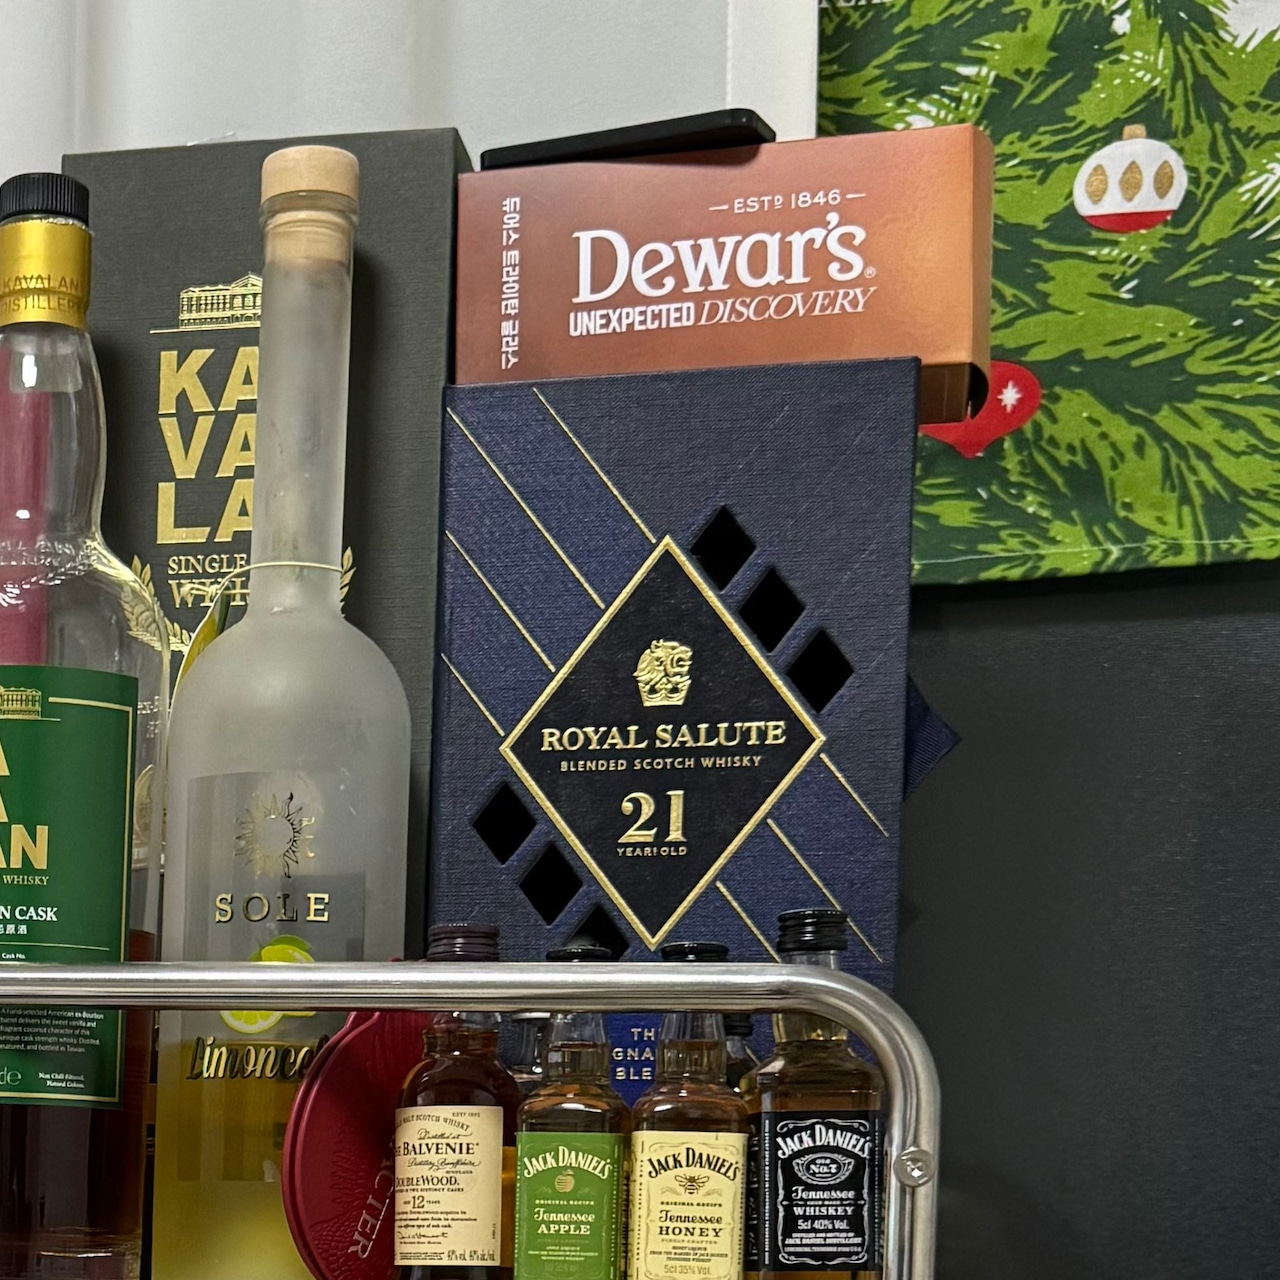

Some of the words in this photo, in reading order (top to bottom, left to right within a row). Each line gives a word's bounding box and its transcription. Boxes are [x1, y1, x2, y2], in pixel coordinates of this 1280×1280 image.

[791, 189, 841, 210] 1846
[502, 197, 520, 246] 듀어스
[571, 212, 867, 304] Dewar's
[1, 274, 80, 293] KAVALAN
[501, 250, 520, 315] 트라이탄
[569, 302, 695, 337] UNEXPECTED
[697, 287, 877, 326] DISCOVERY
[158, 346, 259, 415] KA
[158, 413, 257, 479] VA
[157, 478, 255, 544] LA
[167, 553, 248, 575] SINGLE
[540, 725, 649, 752] ROYAL
[654, 720, 787, 750] SALUTE
[560, 758, 627, 772] BLENDED
[632, 757, 695, 770] SCOTCH
[700, 755, 762, 768] WHISKY
[617, 789, 687, 843] 21
[660, 845, 687, 856] OLD
[3, 875, 49, 886] WHISKY
[14, 906, 58, 922] CASK
[215, 891, 330, 923] SOLE
[186, 1034, 329, 1081] Limonce
[403, 1141, 476, 1156] BALVENIE
[776, 1129, 814, 1159] JACK
[815, 1124, 872, 1160] DANIEL'S
[524, 1151, 556, 1178] JACK
[558, 1146, 613, 1179] DANIEL'S
[647, 1152, 683, 1179] JACK
[685, 1147, 740, 1182] DANIEL'S
[411, 1194, 425, 1209] 12
[791, 1186, 856, 1199] Tennessee
[533, 1207, 596, 1222] Tennessee
[658, 1209, 723, 1224] Tennessee
[793, 1206, 855, 1216] WHISKEY
[537, 1223, 591, 1235] APPLE
[658, 1226, 723, 1238] HONEY
[813, 1219, 833, 1230] 40%
